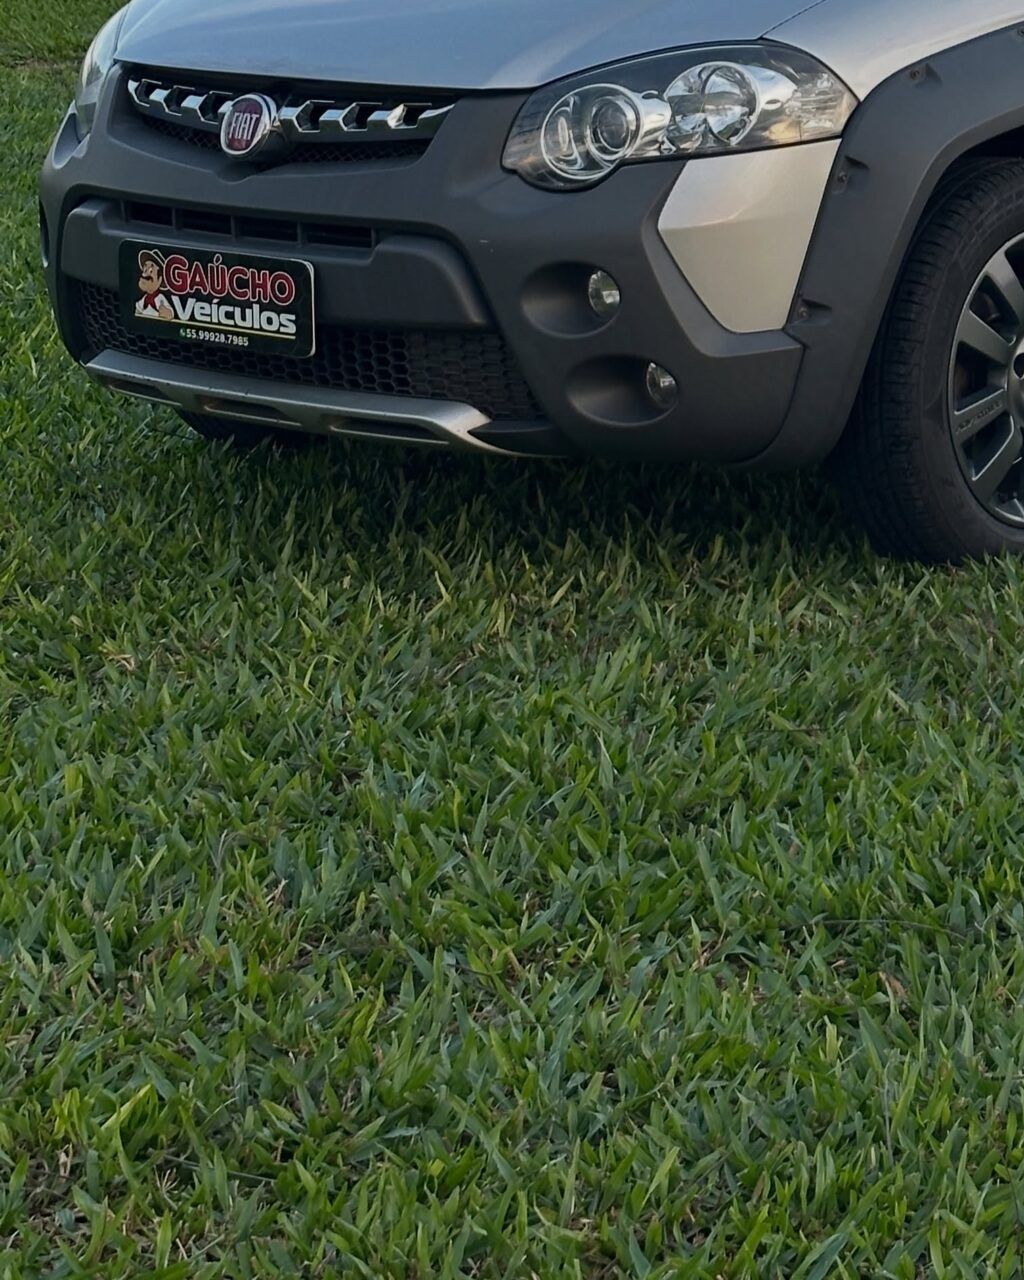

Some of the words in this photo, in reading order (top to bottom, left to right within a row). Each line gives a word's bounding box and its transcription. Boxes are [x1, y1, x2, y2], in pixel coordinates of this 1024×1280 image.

[228, 112, 260, 140] FIAT
[164, 254, 295, 305] GAÚCHO
[171, 295, 296, 334] Veículos
